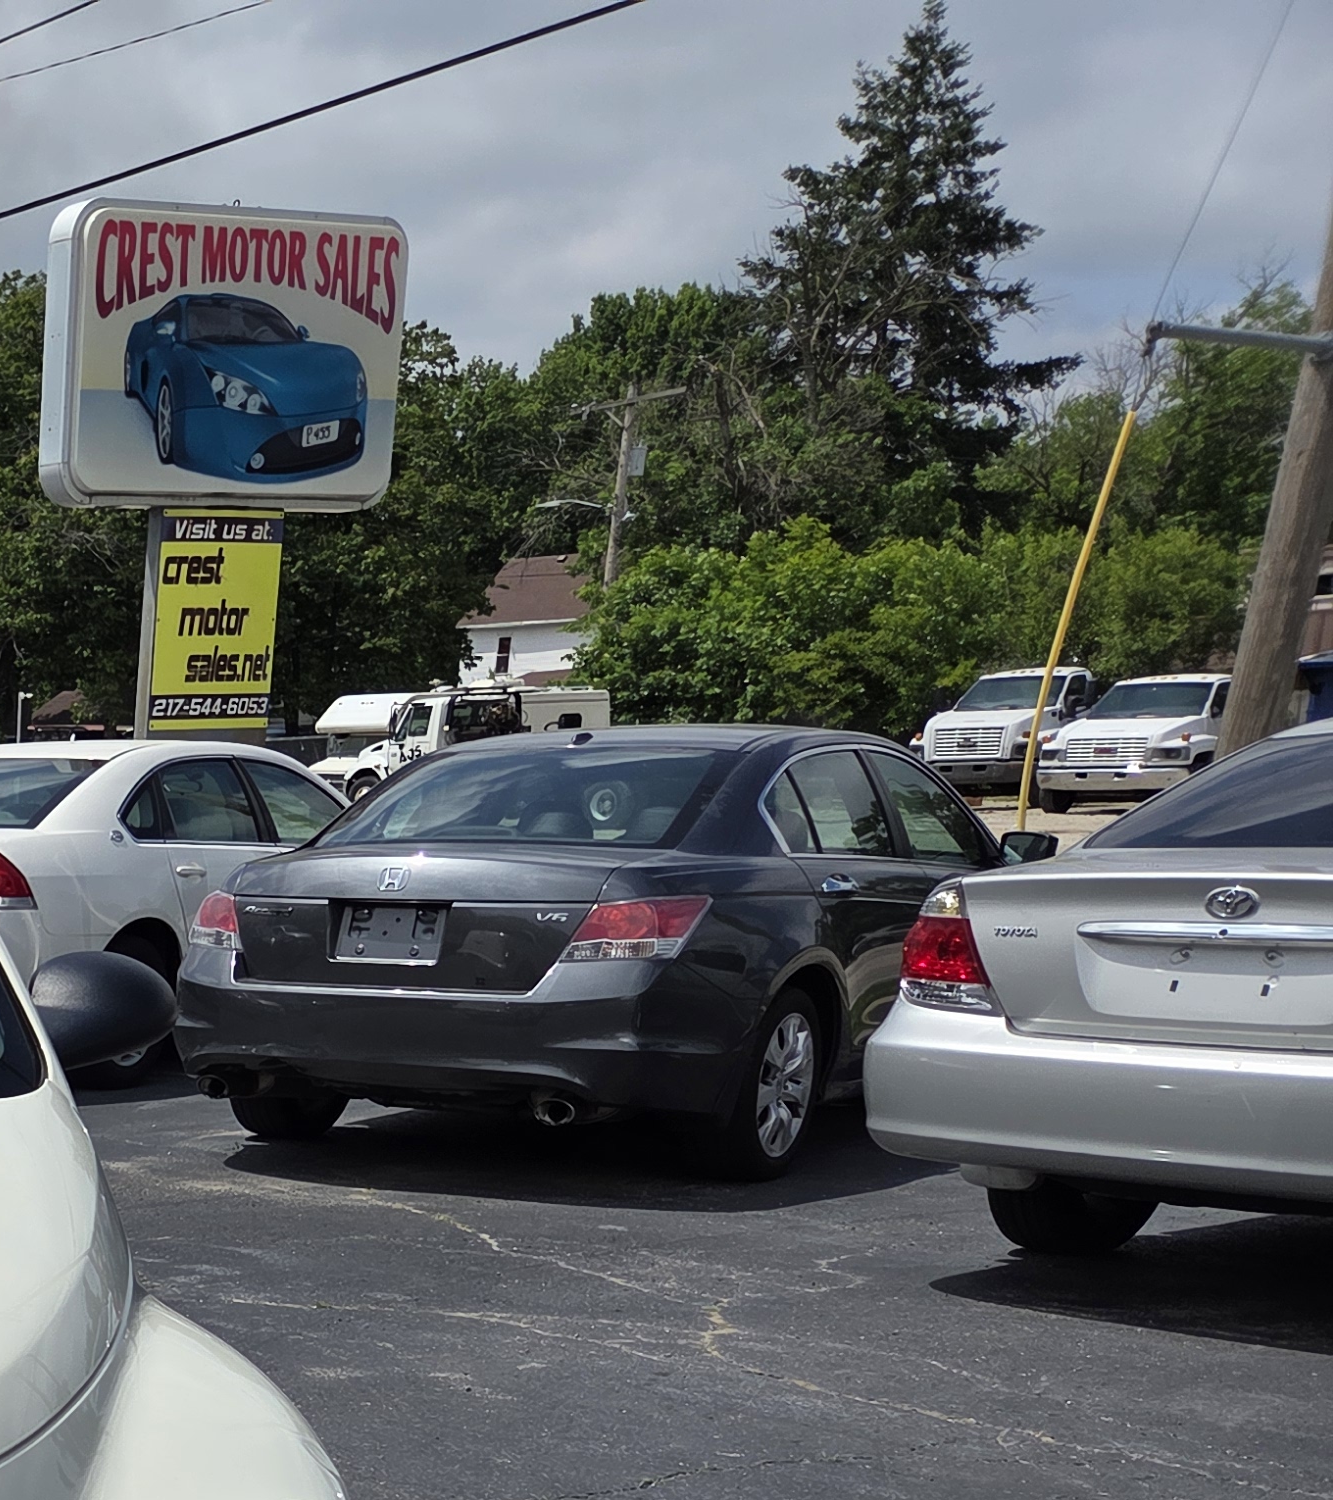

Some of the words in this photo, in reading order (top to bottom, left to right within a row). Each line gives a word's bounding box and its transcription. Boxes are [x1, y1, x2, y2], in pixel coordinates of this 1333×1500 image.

[95, 218, 196, 319] CREST
[201, 225, 307, 290] MOTOR
[314, 232, 400, 335] SALES
[175, 519, 218, 539] Visit
[222, 524, 247, 540] us
[251, 521, 274, 540] at:
[162, 547, 225, 585] crest
[178, 599, 250, 637] motor
[184, 645, 271, 682] sales.net
[152, 697, 269, 717] 217-544-6053
[535, 912, 569, 922] V6
[993, 926, 1038, 938] TOYOTA
